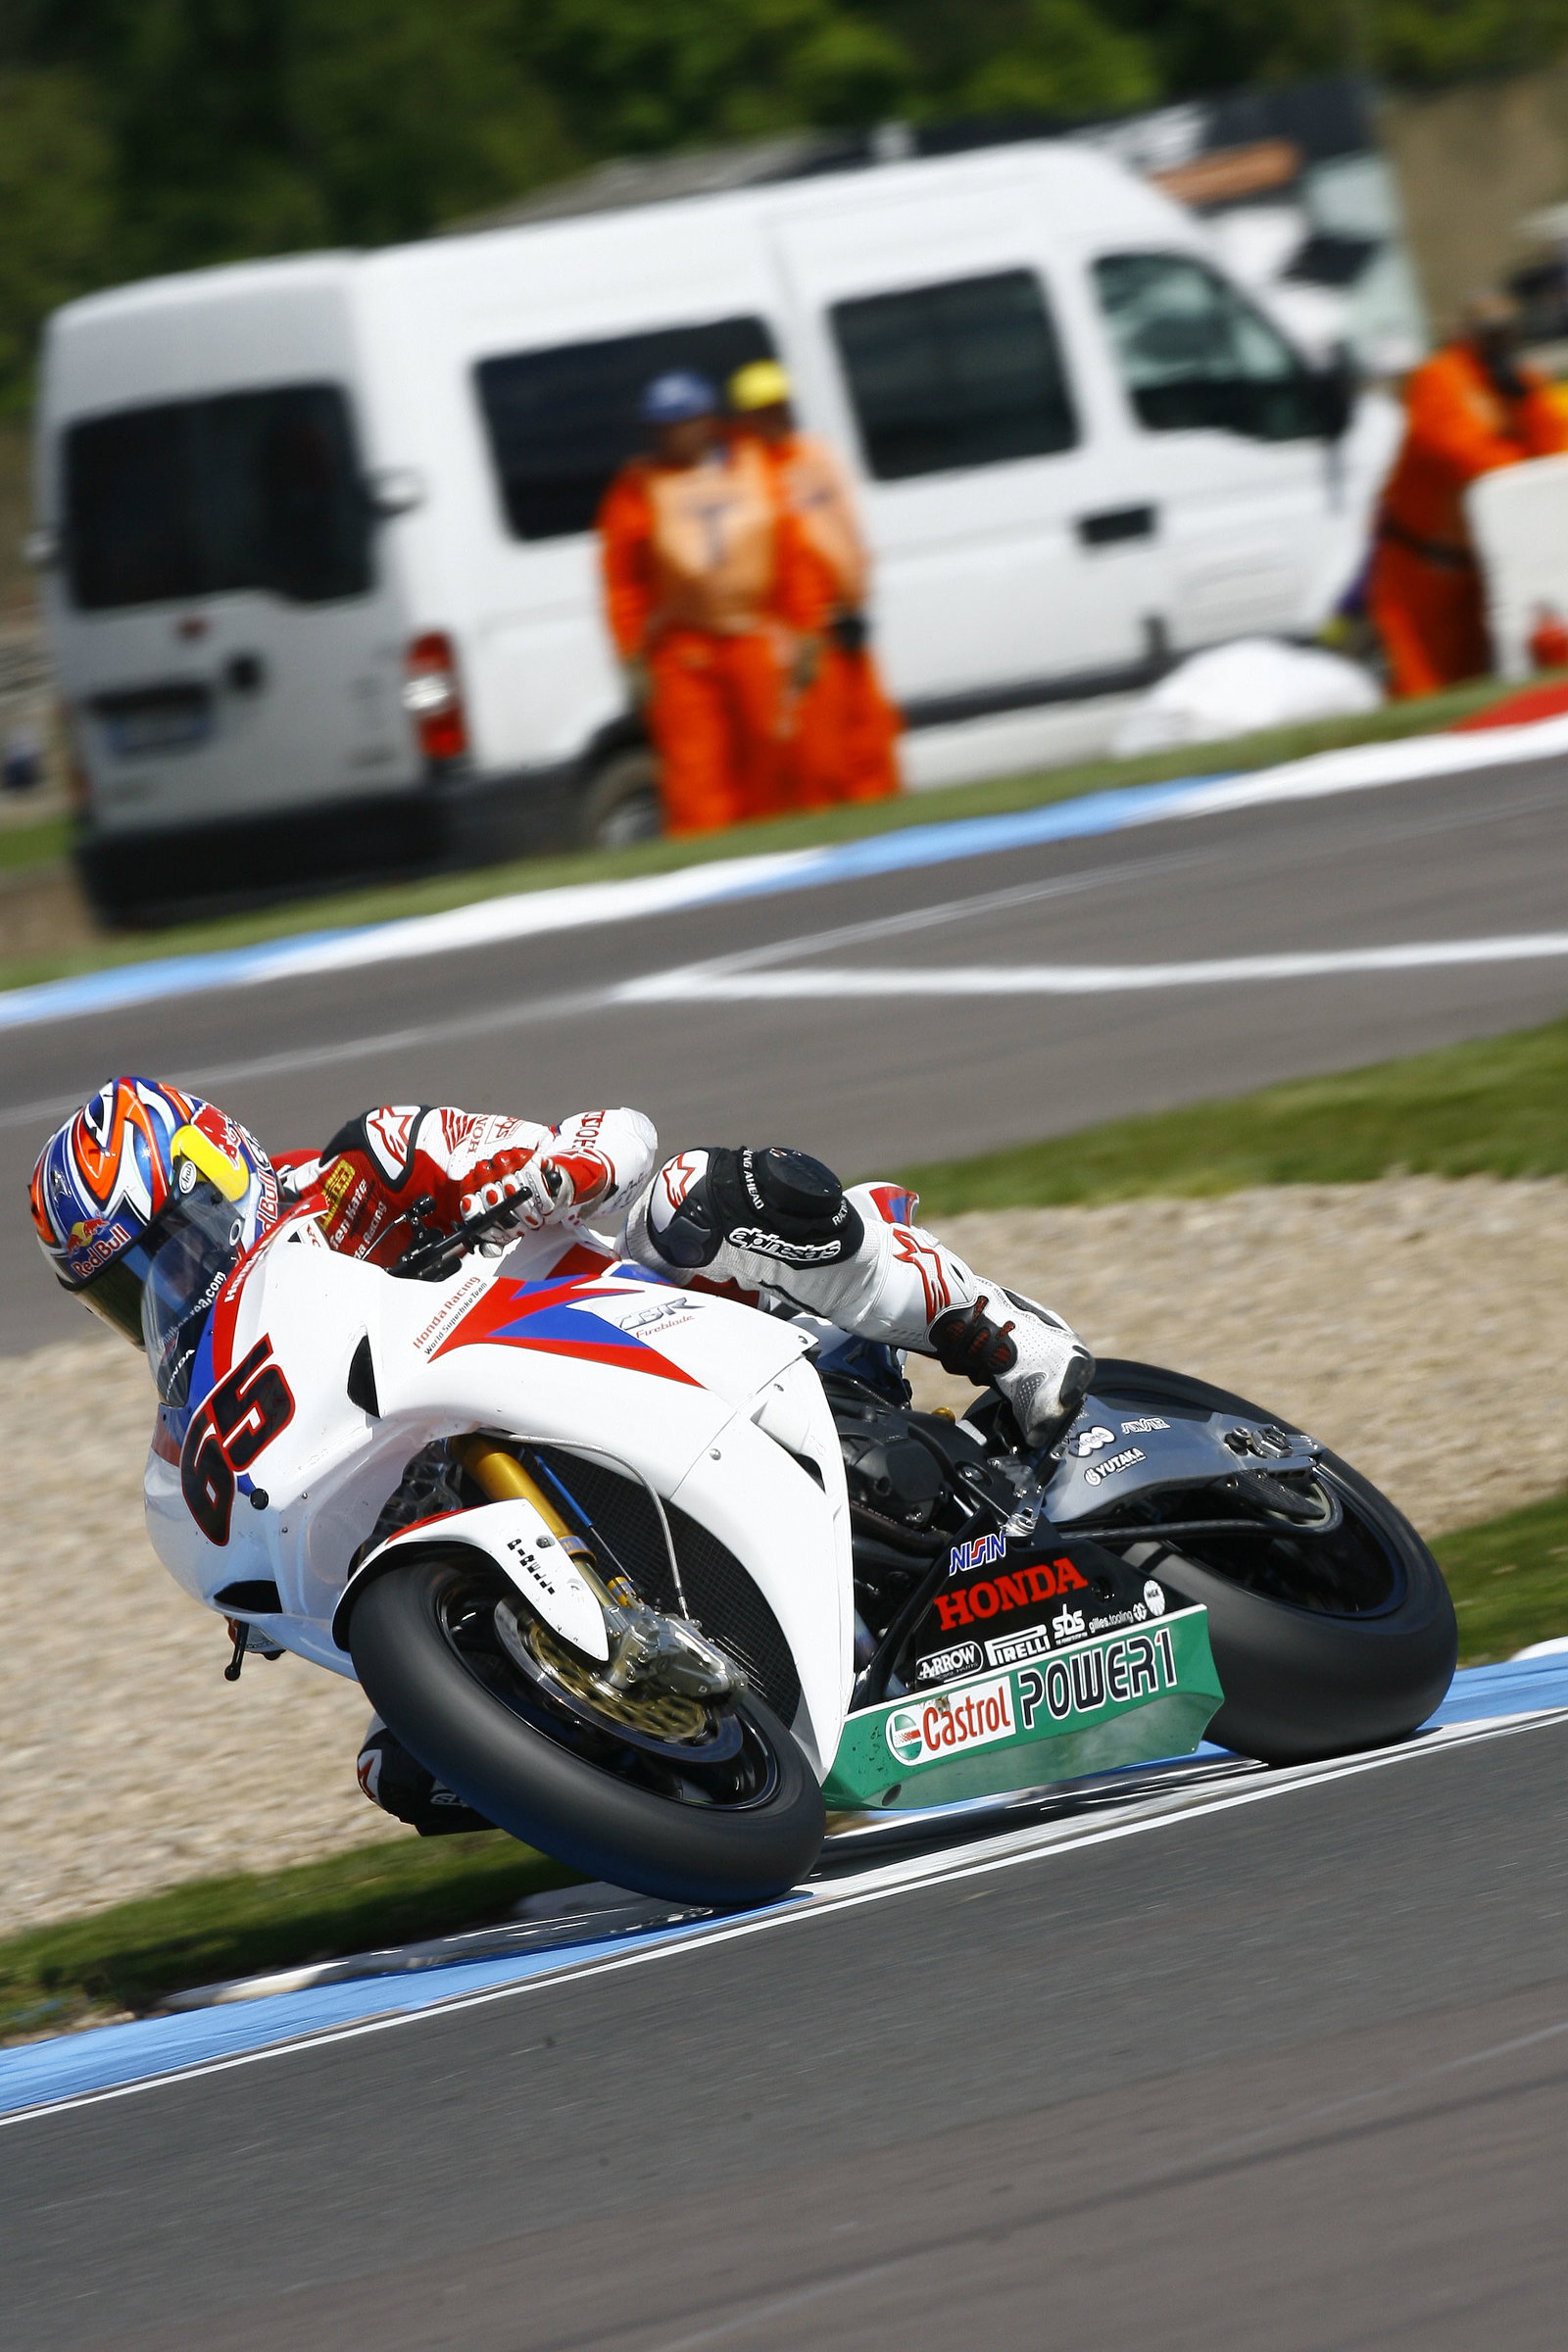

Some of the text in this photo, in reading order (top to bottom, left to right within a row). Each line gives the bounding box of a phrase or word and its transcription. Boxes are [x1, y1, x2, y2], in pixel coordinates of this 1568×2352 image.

[467, 1115, 489, 1153] HON
[572, 1109, 606, 1149] HON
[182, 1163, 194, 1192] Arai
[259, 1170, 279, 1222] Bull
[346, 1179, 368, 1220] Kate
[744, 1171, 764, 1210] AHEAD
[363, 1200, 387, 1245] Racing
[73, 1223, 131, 1278] Red Bull
[413, 1275, 481, 1349] Honda Racing
[423, 1282, 488, 1356] World Superbike Team
[635, 1315, 696, 1340] Fireblade
[180, 1332, 296, 1546] 65
[1095, 1447, 1145, 1477] YUTAKA
[933, 1557, 1089, 1631] HONDA
[918, 1644, 975, 1681] ARROW
[984, 1624, 1051, 1667] PIRELLI
[1052, 1603, 1086, 1640] sbs
[922, 1627, 1178, 1751] Castrol POWER1
